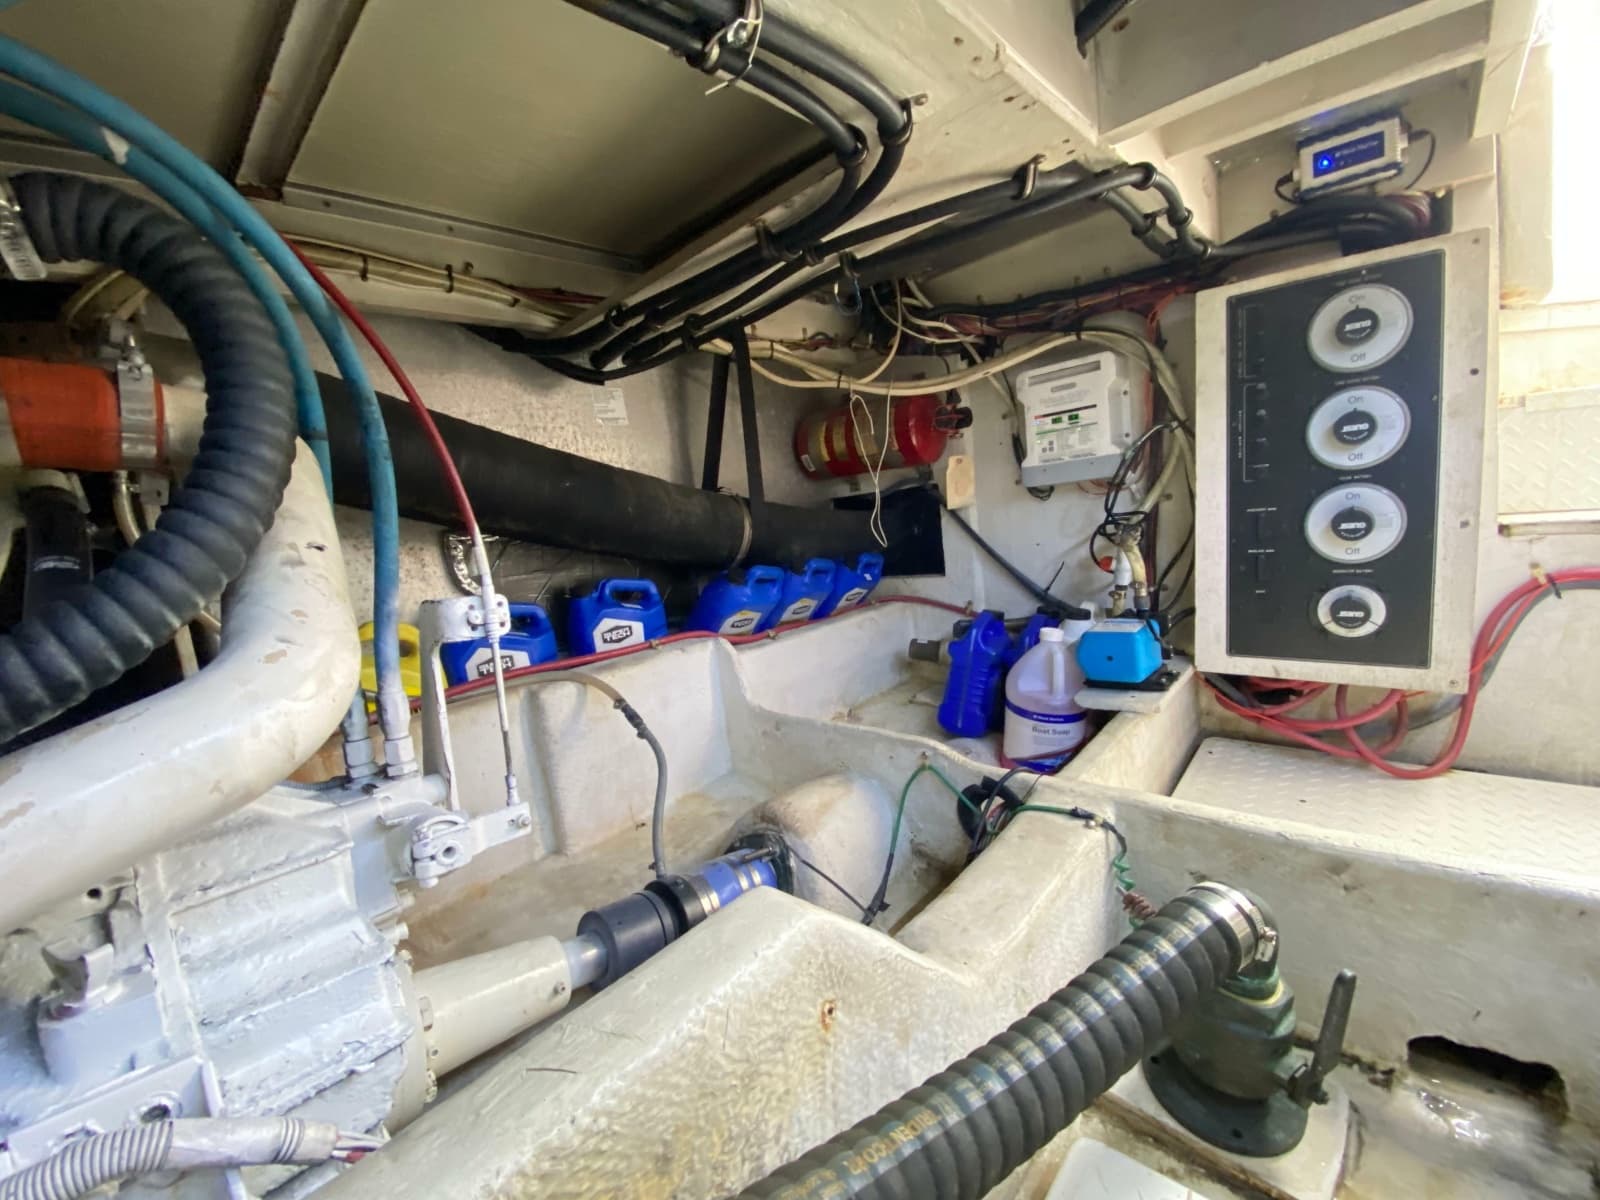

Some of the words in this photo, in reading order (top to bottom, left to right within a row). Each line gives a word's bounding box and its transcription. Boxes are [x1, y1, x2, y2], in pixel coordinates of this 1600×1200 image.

[1348, 294, 1366, 305] On
[1350, 352, 1367, 363] Off
[1347, 394, 1365, 404] On
[1347, 451, 1364, 462] Off
[1345, 491, 1361, 501] On
[1344, 546, 1361, 556] Off
